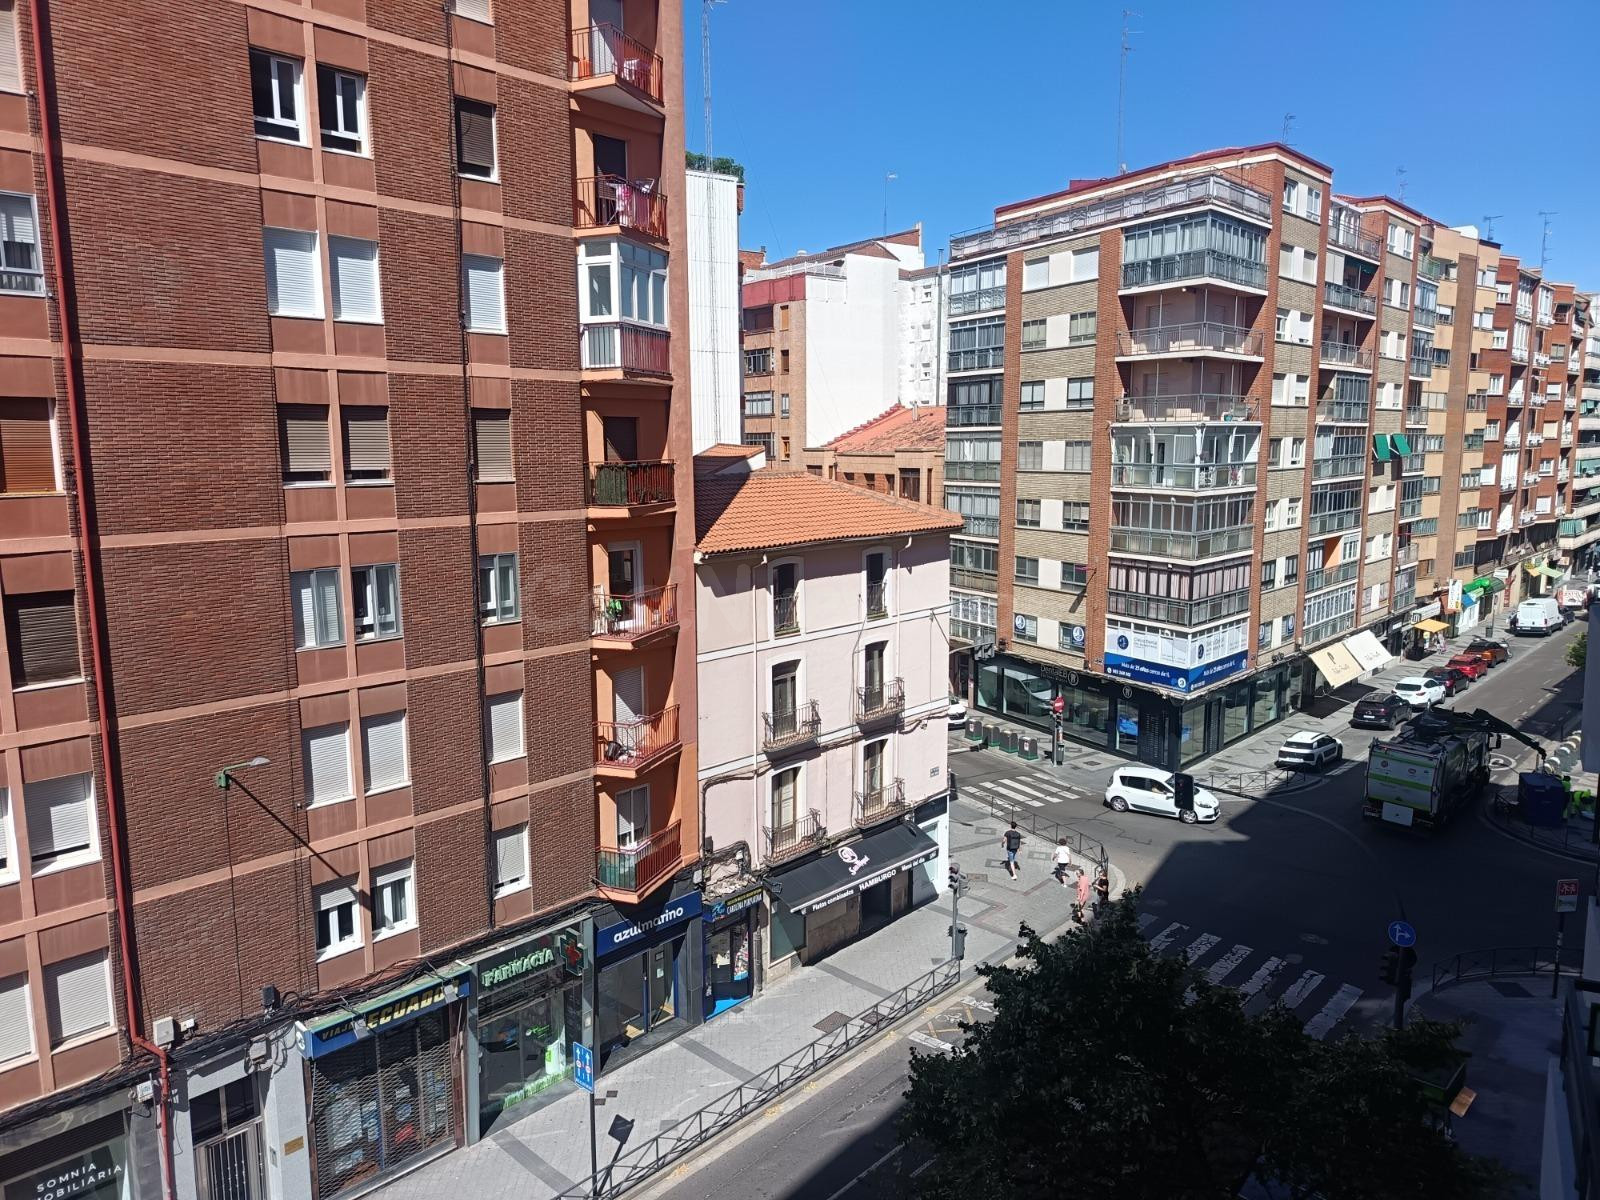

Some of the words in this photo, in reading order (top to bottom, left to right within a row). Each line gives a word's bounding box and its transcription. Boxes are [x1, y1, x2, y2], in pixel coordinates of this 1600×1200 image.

[859, 869, 897, 891] HAMBURGO
[613, 906, 684, 943] azulmarino
[482, 948, 555, 987] FARMACIA
[36, 1163, 97, 1193] SOMNIA
